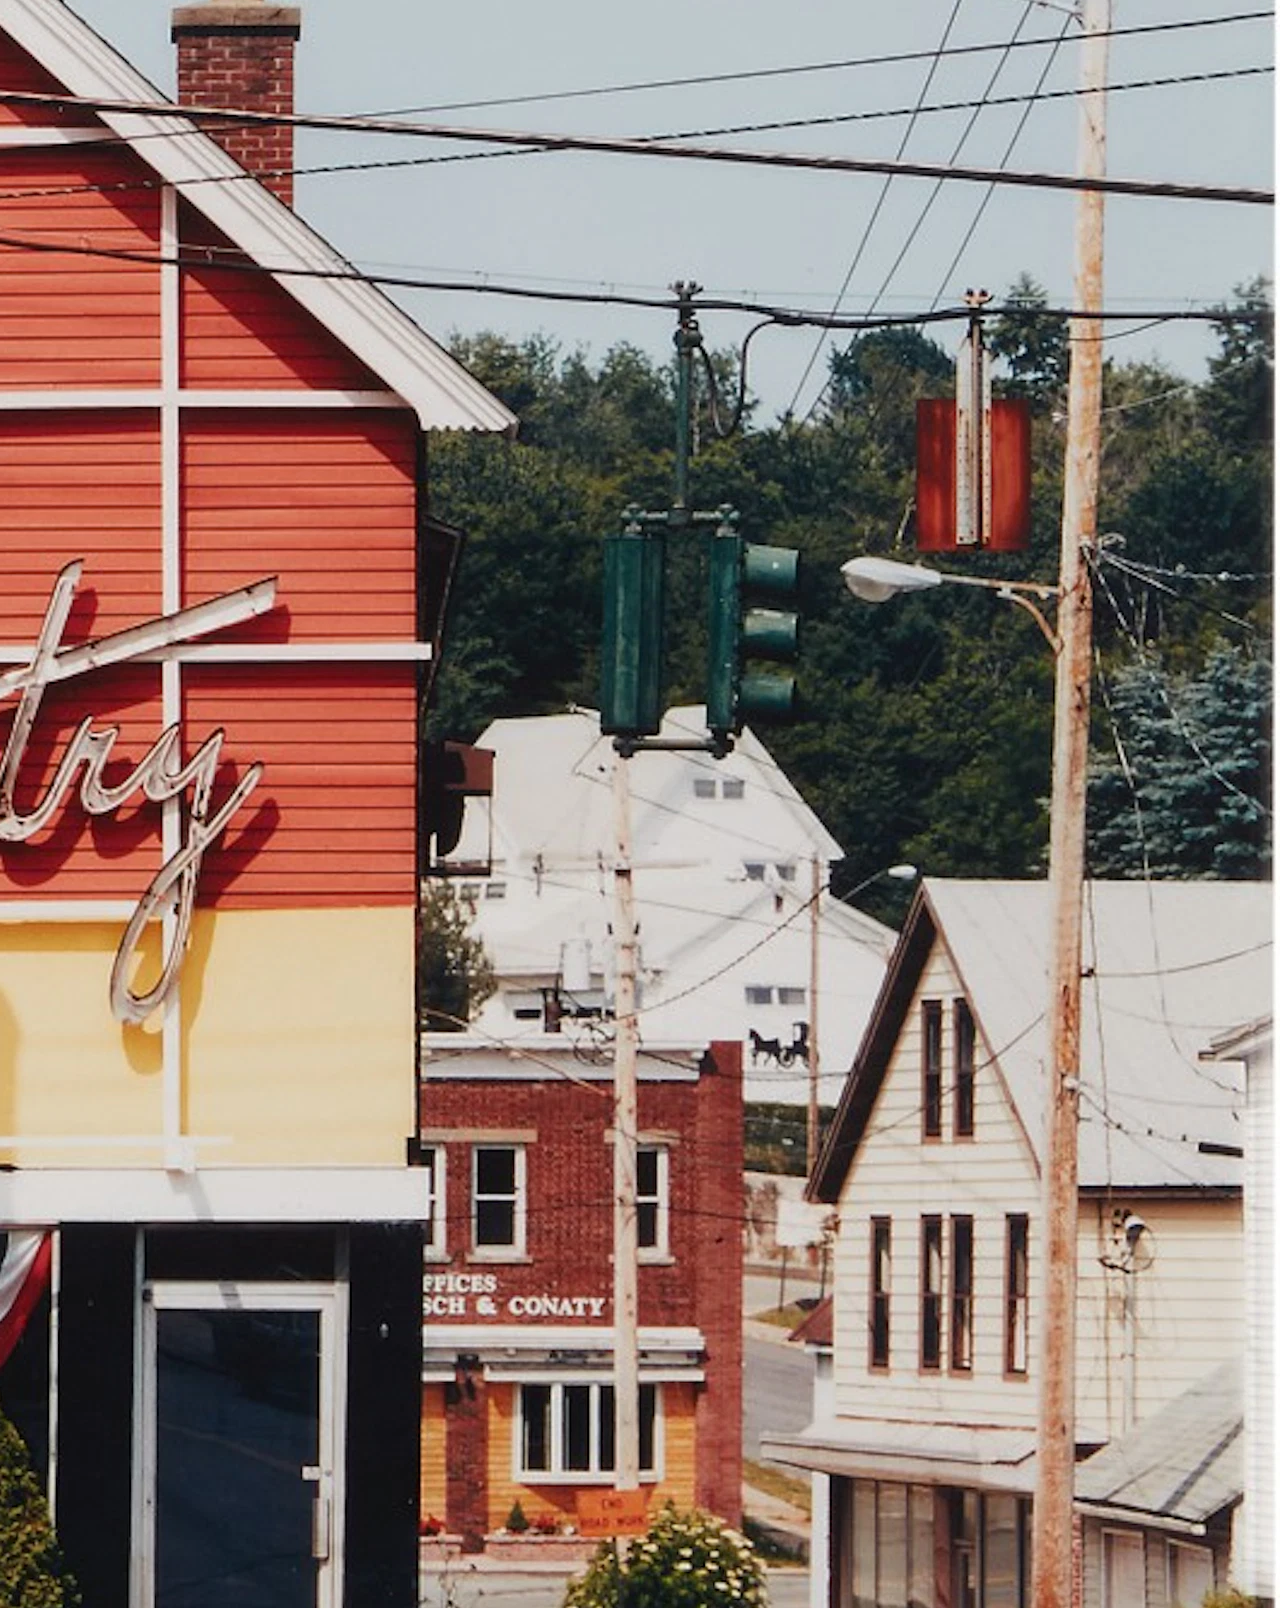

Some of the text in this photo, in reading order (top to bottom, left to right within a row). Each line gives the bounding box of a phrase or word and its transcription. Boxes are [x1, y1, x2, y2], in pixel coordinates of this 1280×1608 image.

[422, 1273, 498, 1293] FFICES
[422, 1294, 606, 1316] SCH & CONATY
